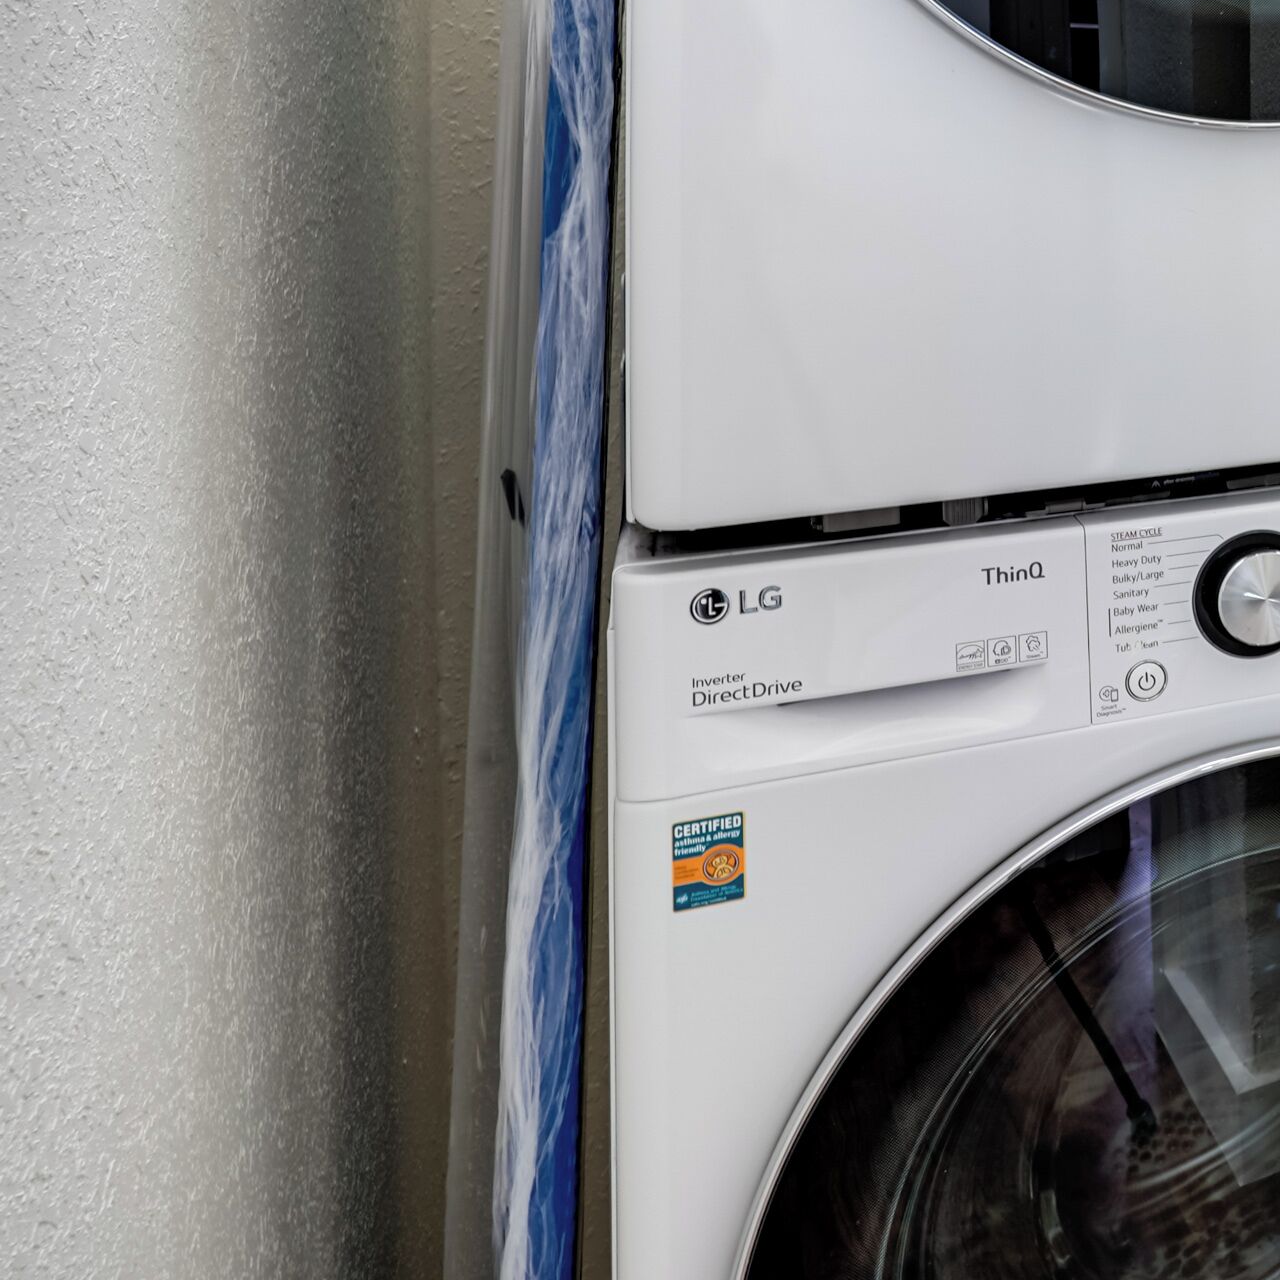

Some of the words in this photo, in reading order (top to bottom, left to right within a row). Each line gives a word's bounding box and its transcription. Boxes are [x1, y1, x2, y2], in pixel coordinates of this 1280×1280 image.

[1110, 531, 1138, 541] STEAM
[1139, 527, 1163, 537] CYCLE
[1111, 541, 1143, 553] Normal
[1111, 557, 1138, 568] Heavy
[1141, 555, 1162, 565] Duty
[981, 561, 1045, 585] ThinQ
[1112, 570, 1164, 585] Bulky/Large
[738, 585, 782, 614] LG
[1112, 587, 1150, 600] Sanitary
[1113, 605, 1135, 617] Baby
[1137, 603, 1159, 613] Wear
[1115, 642, 1132, 653] Tub
[692, 672, 746, 688] Inverter
[673, 814, 742, 839] CERTIFIED
[674, 836, 705, 848] asthma
[706, 834, 712, 842] &
[712, 829, 741, 841] allergy
[674, 844, 706, 857] friendly
